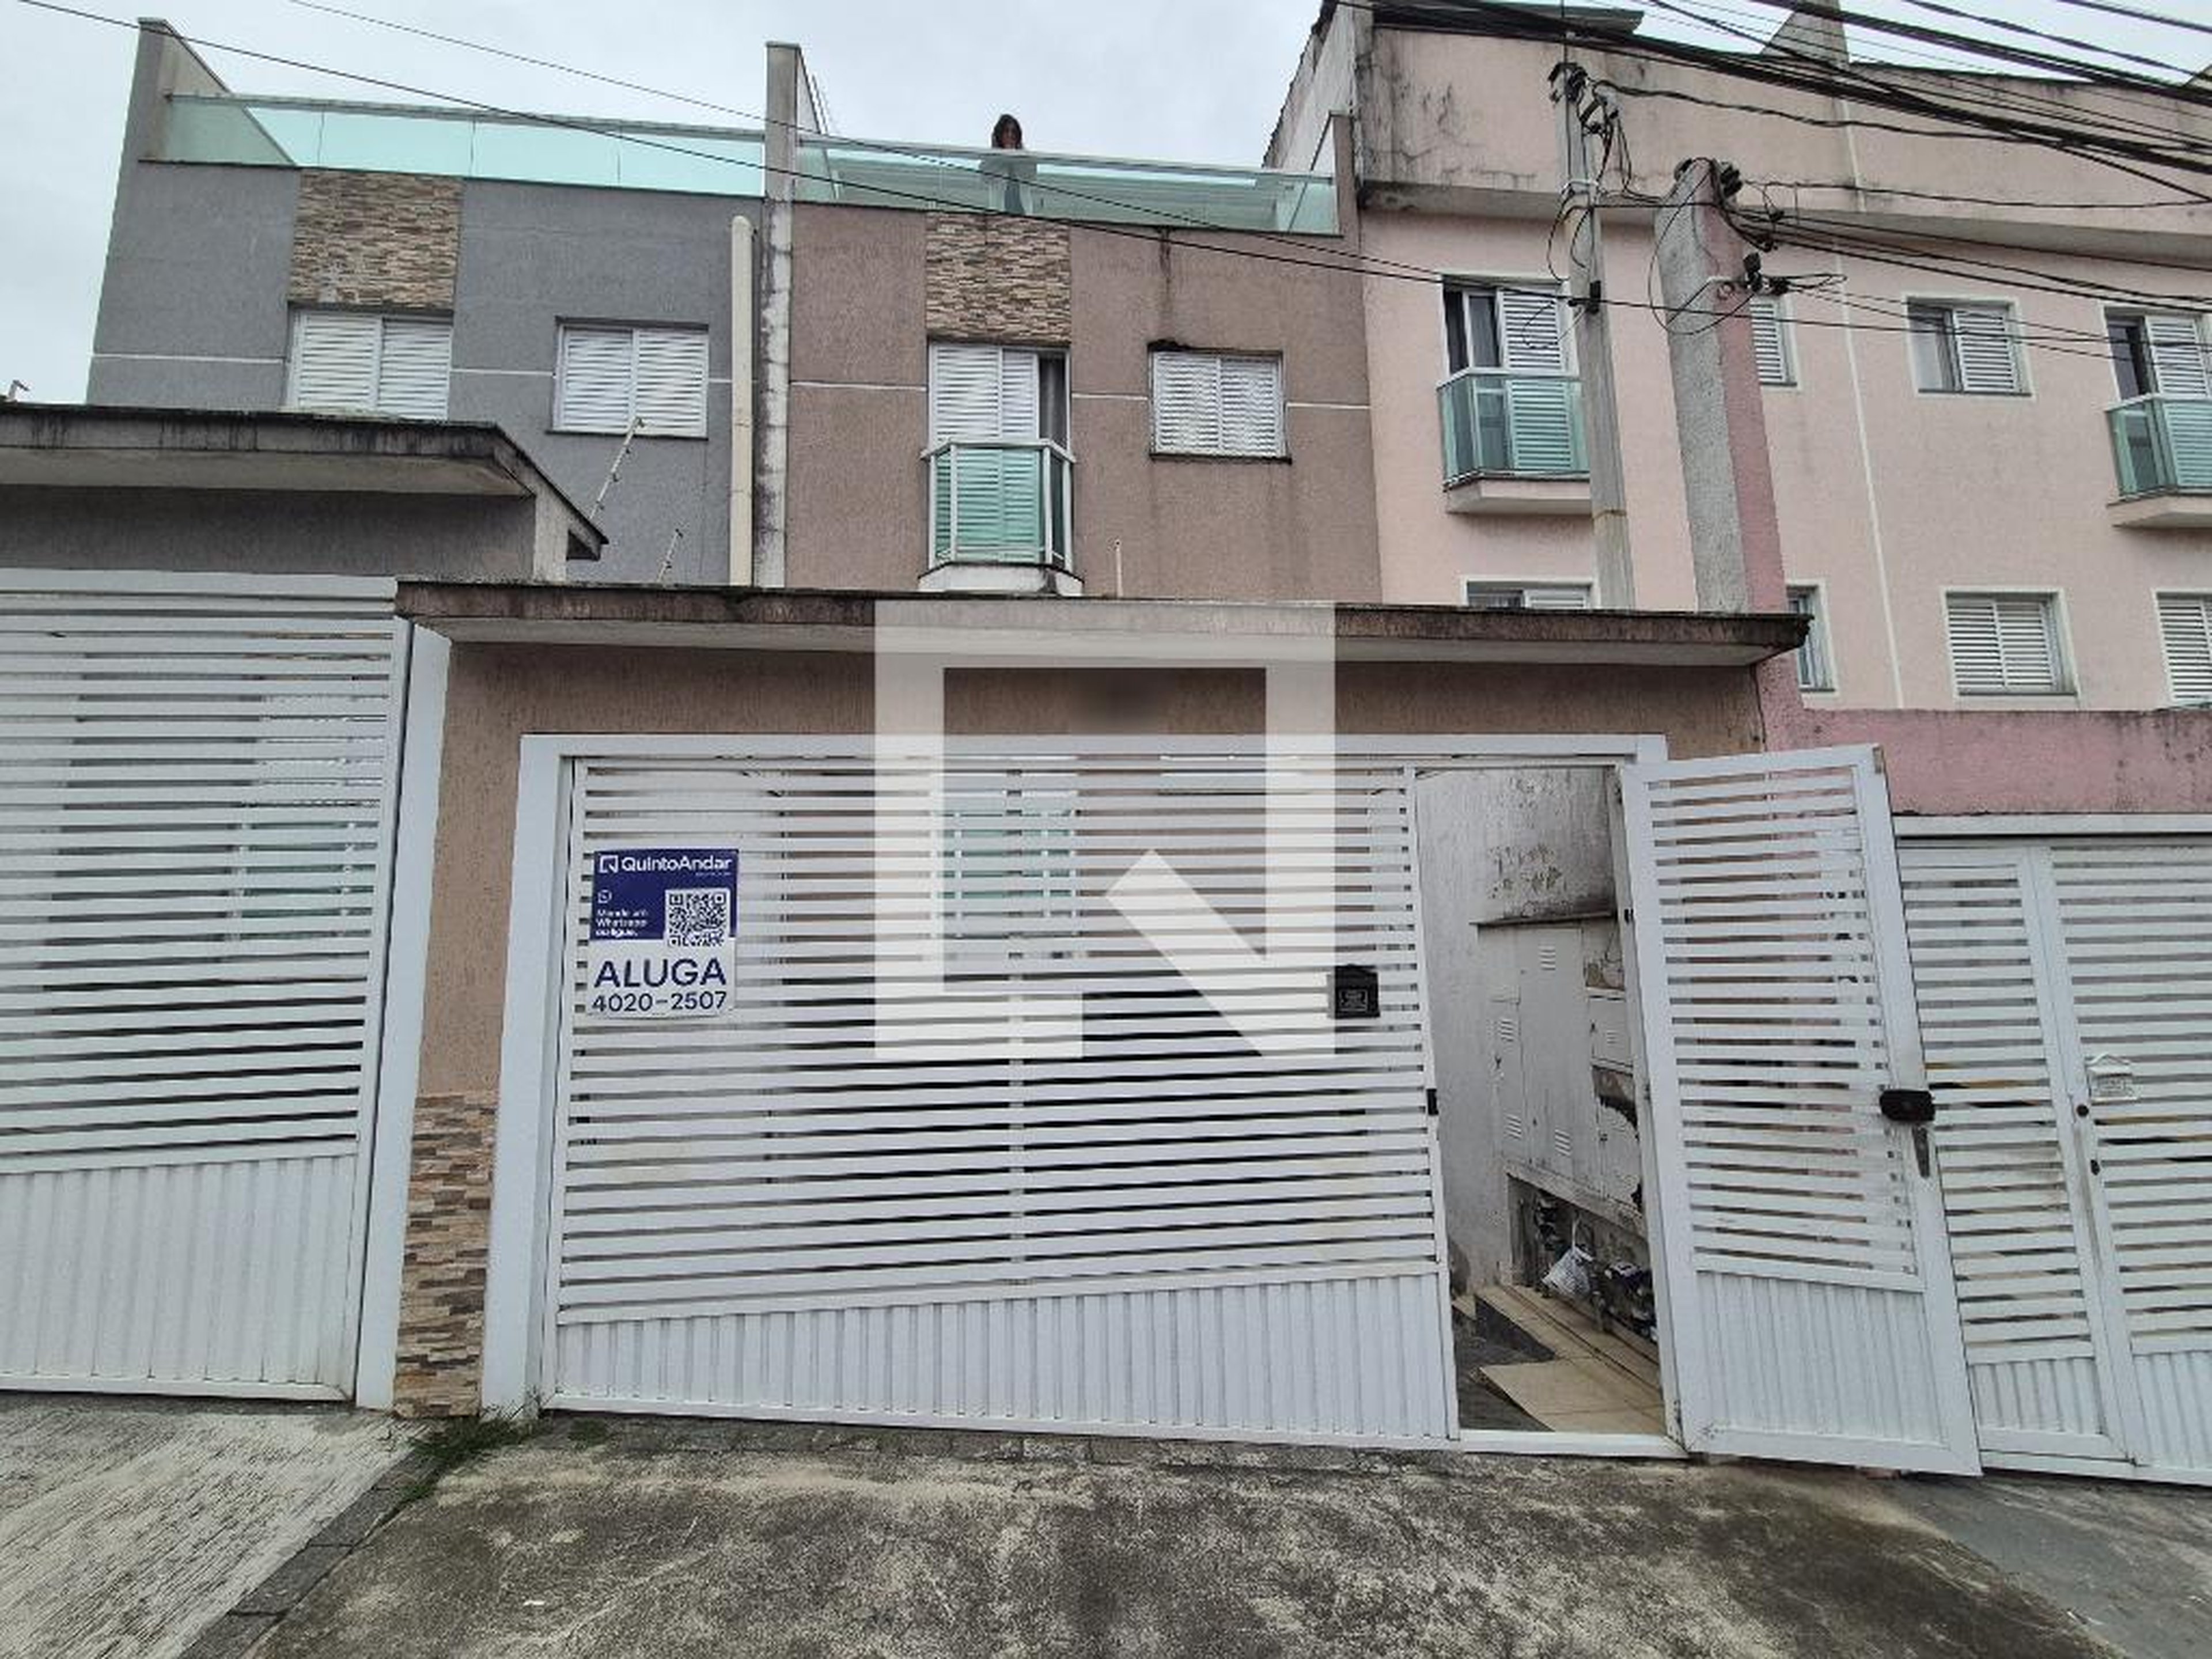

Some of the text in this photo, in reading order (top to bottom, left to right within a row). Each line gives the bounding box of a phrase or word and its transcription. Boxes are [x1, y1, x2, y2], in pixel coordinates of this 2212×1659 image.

[622, 855, 733, 872] QuintoAndar
[594, 958, 726, 987] ALUGA
[592, 991, 727, 1012] 4020-2507
